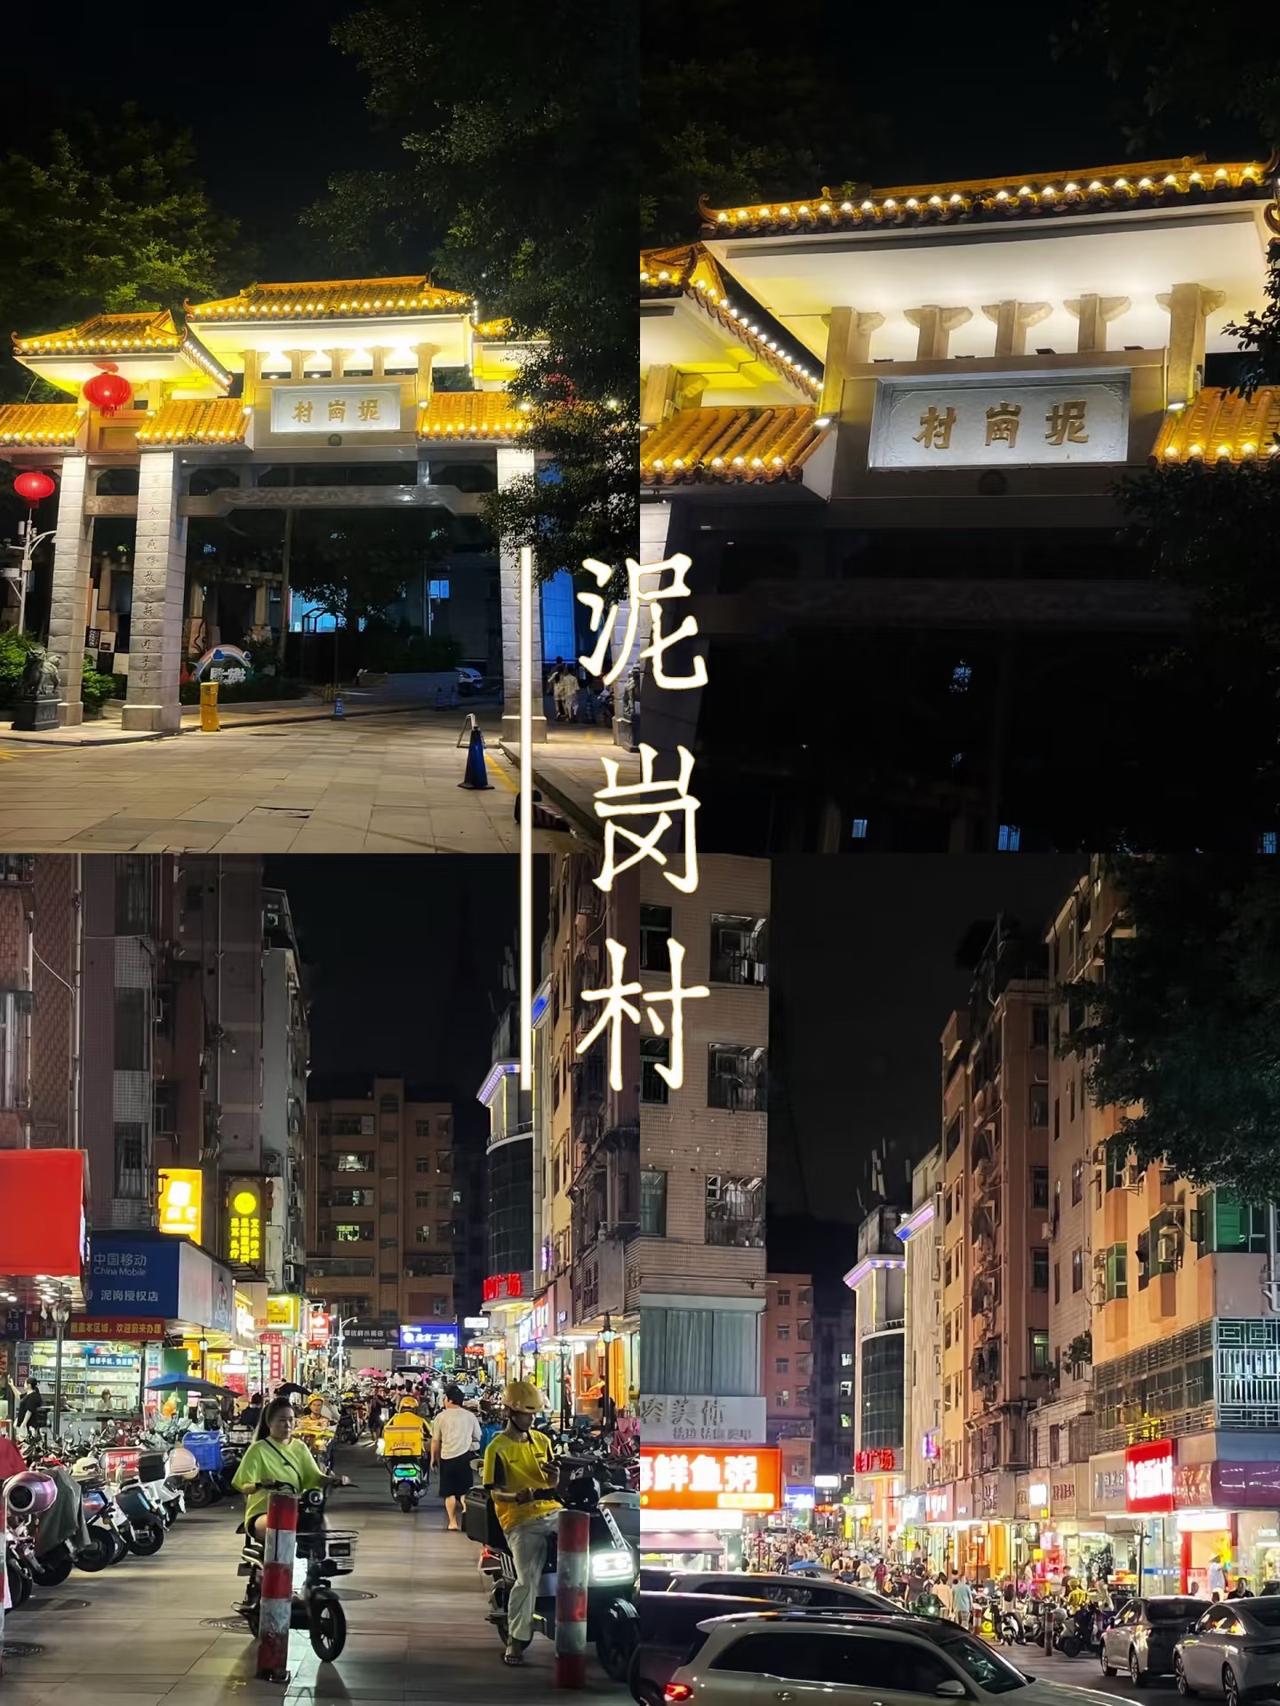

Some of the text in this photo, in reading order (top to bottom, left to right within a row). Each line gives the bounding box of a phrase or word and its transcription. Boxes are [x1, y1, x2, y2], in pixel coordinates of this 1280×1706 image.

[93, 1252, 148, 1267] 中国移动
[93, 1267, 147, 1277] China Mobile
[100, 1289, 160, 1303] 泥岗授权店
